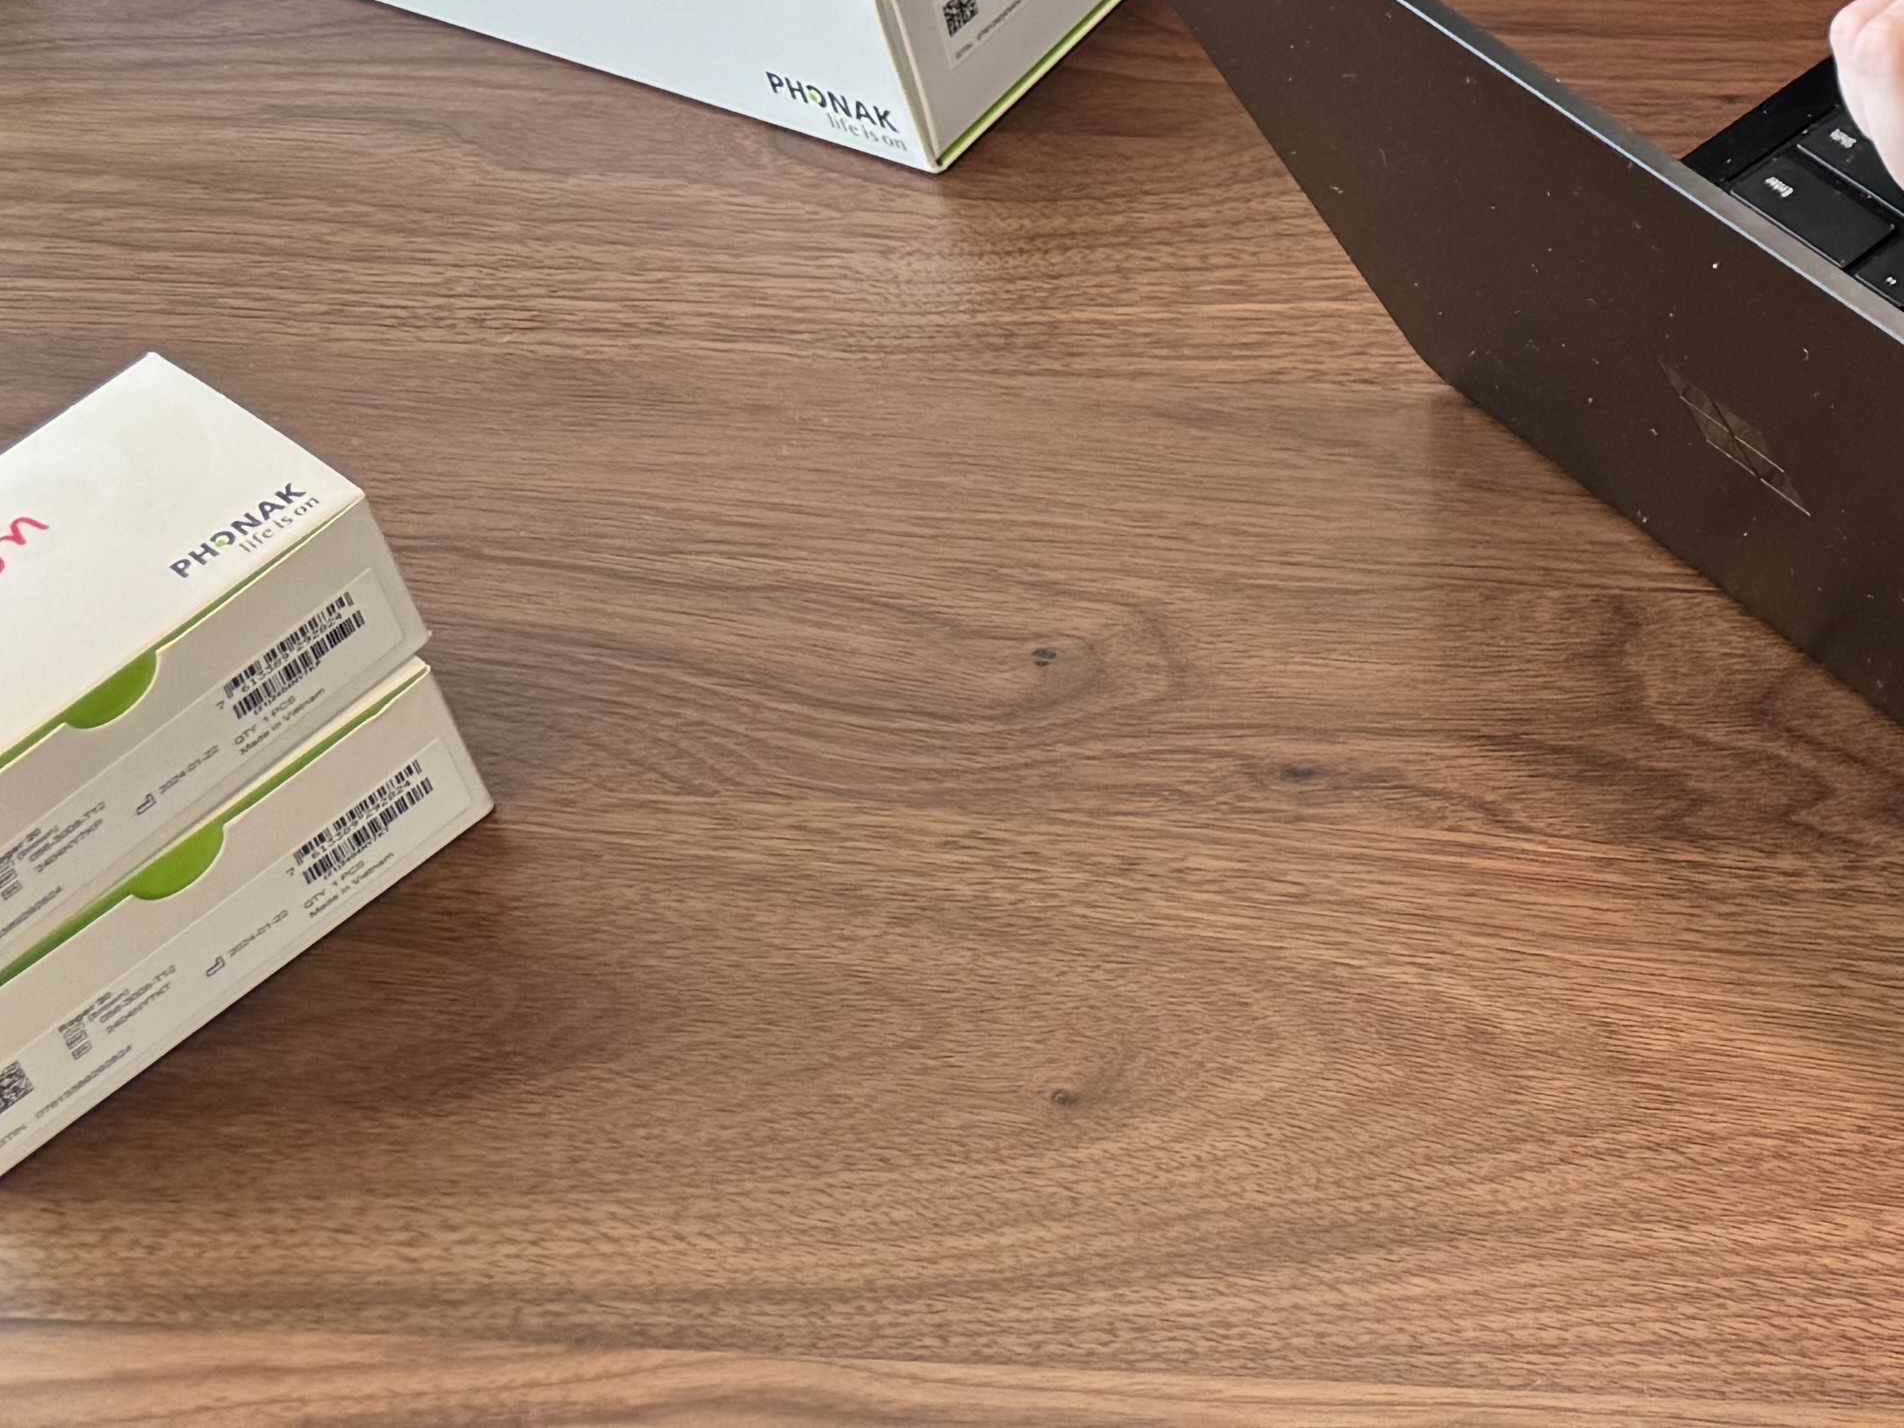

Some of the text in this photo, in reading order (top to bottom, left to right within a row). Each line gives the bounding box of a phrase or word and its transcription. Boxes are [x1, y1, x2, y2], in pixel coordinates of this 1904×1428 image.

[766, 72, 898, 132] PHONAK
[827, 113, 858, 136] life
[882, 135, 906, 151] on
[170, 483, 306, 578] PHONAK
[239, 498, 319, 552] life is on
[239, 686, 325, 755] Made in Vietnam
[270, 694, 296, 717] PCS
[302, 888, 326, 909] QTY
[340, 859, 365, 881] PCS
[309, 851, 394, 918] Made in Vietnam
